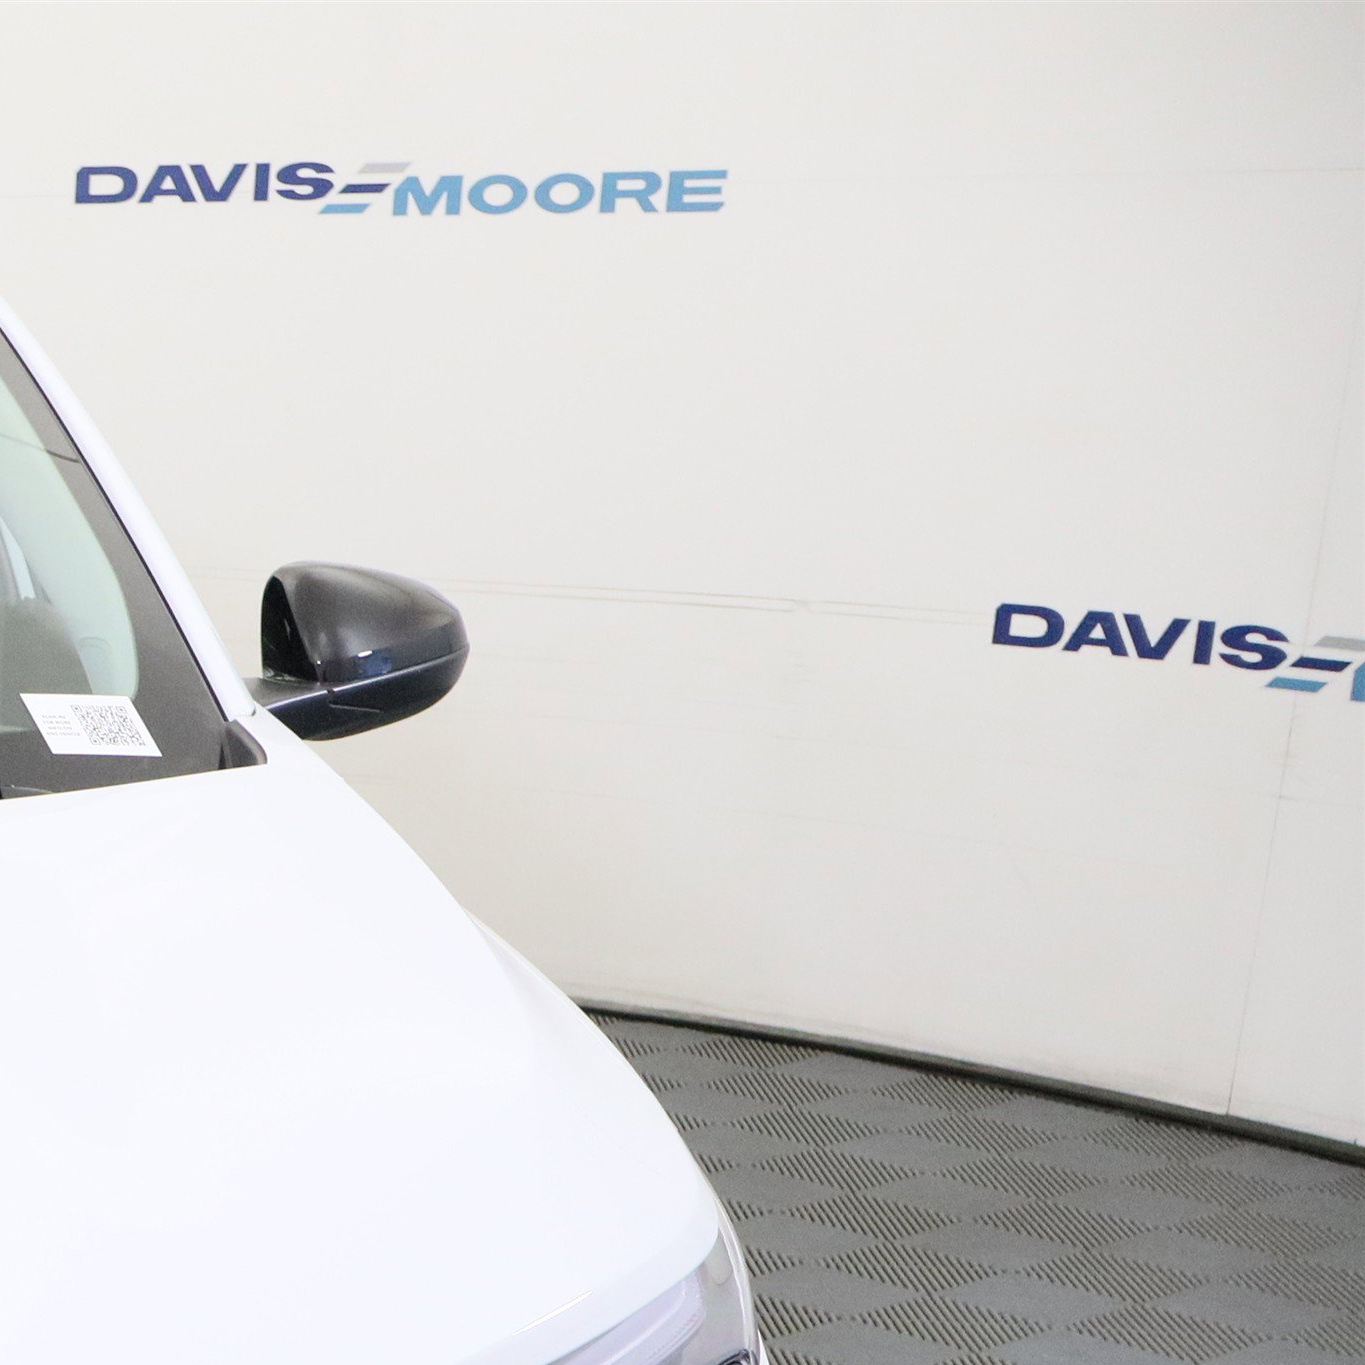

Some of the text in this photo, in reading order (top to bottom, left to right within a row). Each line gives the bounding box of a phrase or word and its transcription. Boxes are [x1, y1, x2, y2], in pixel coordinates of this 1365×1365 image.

[76, 161, 729, 216] DAVIS MOORE
[991, 602, 1288, 671] DAVIS
